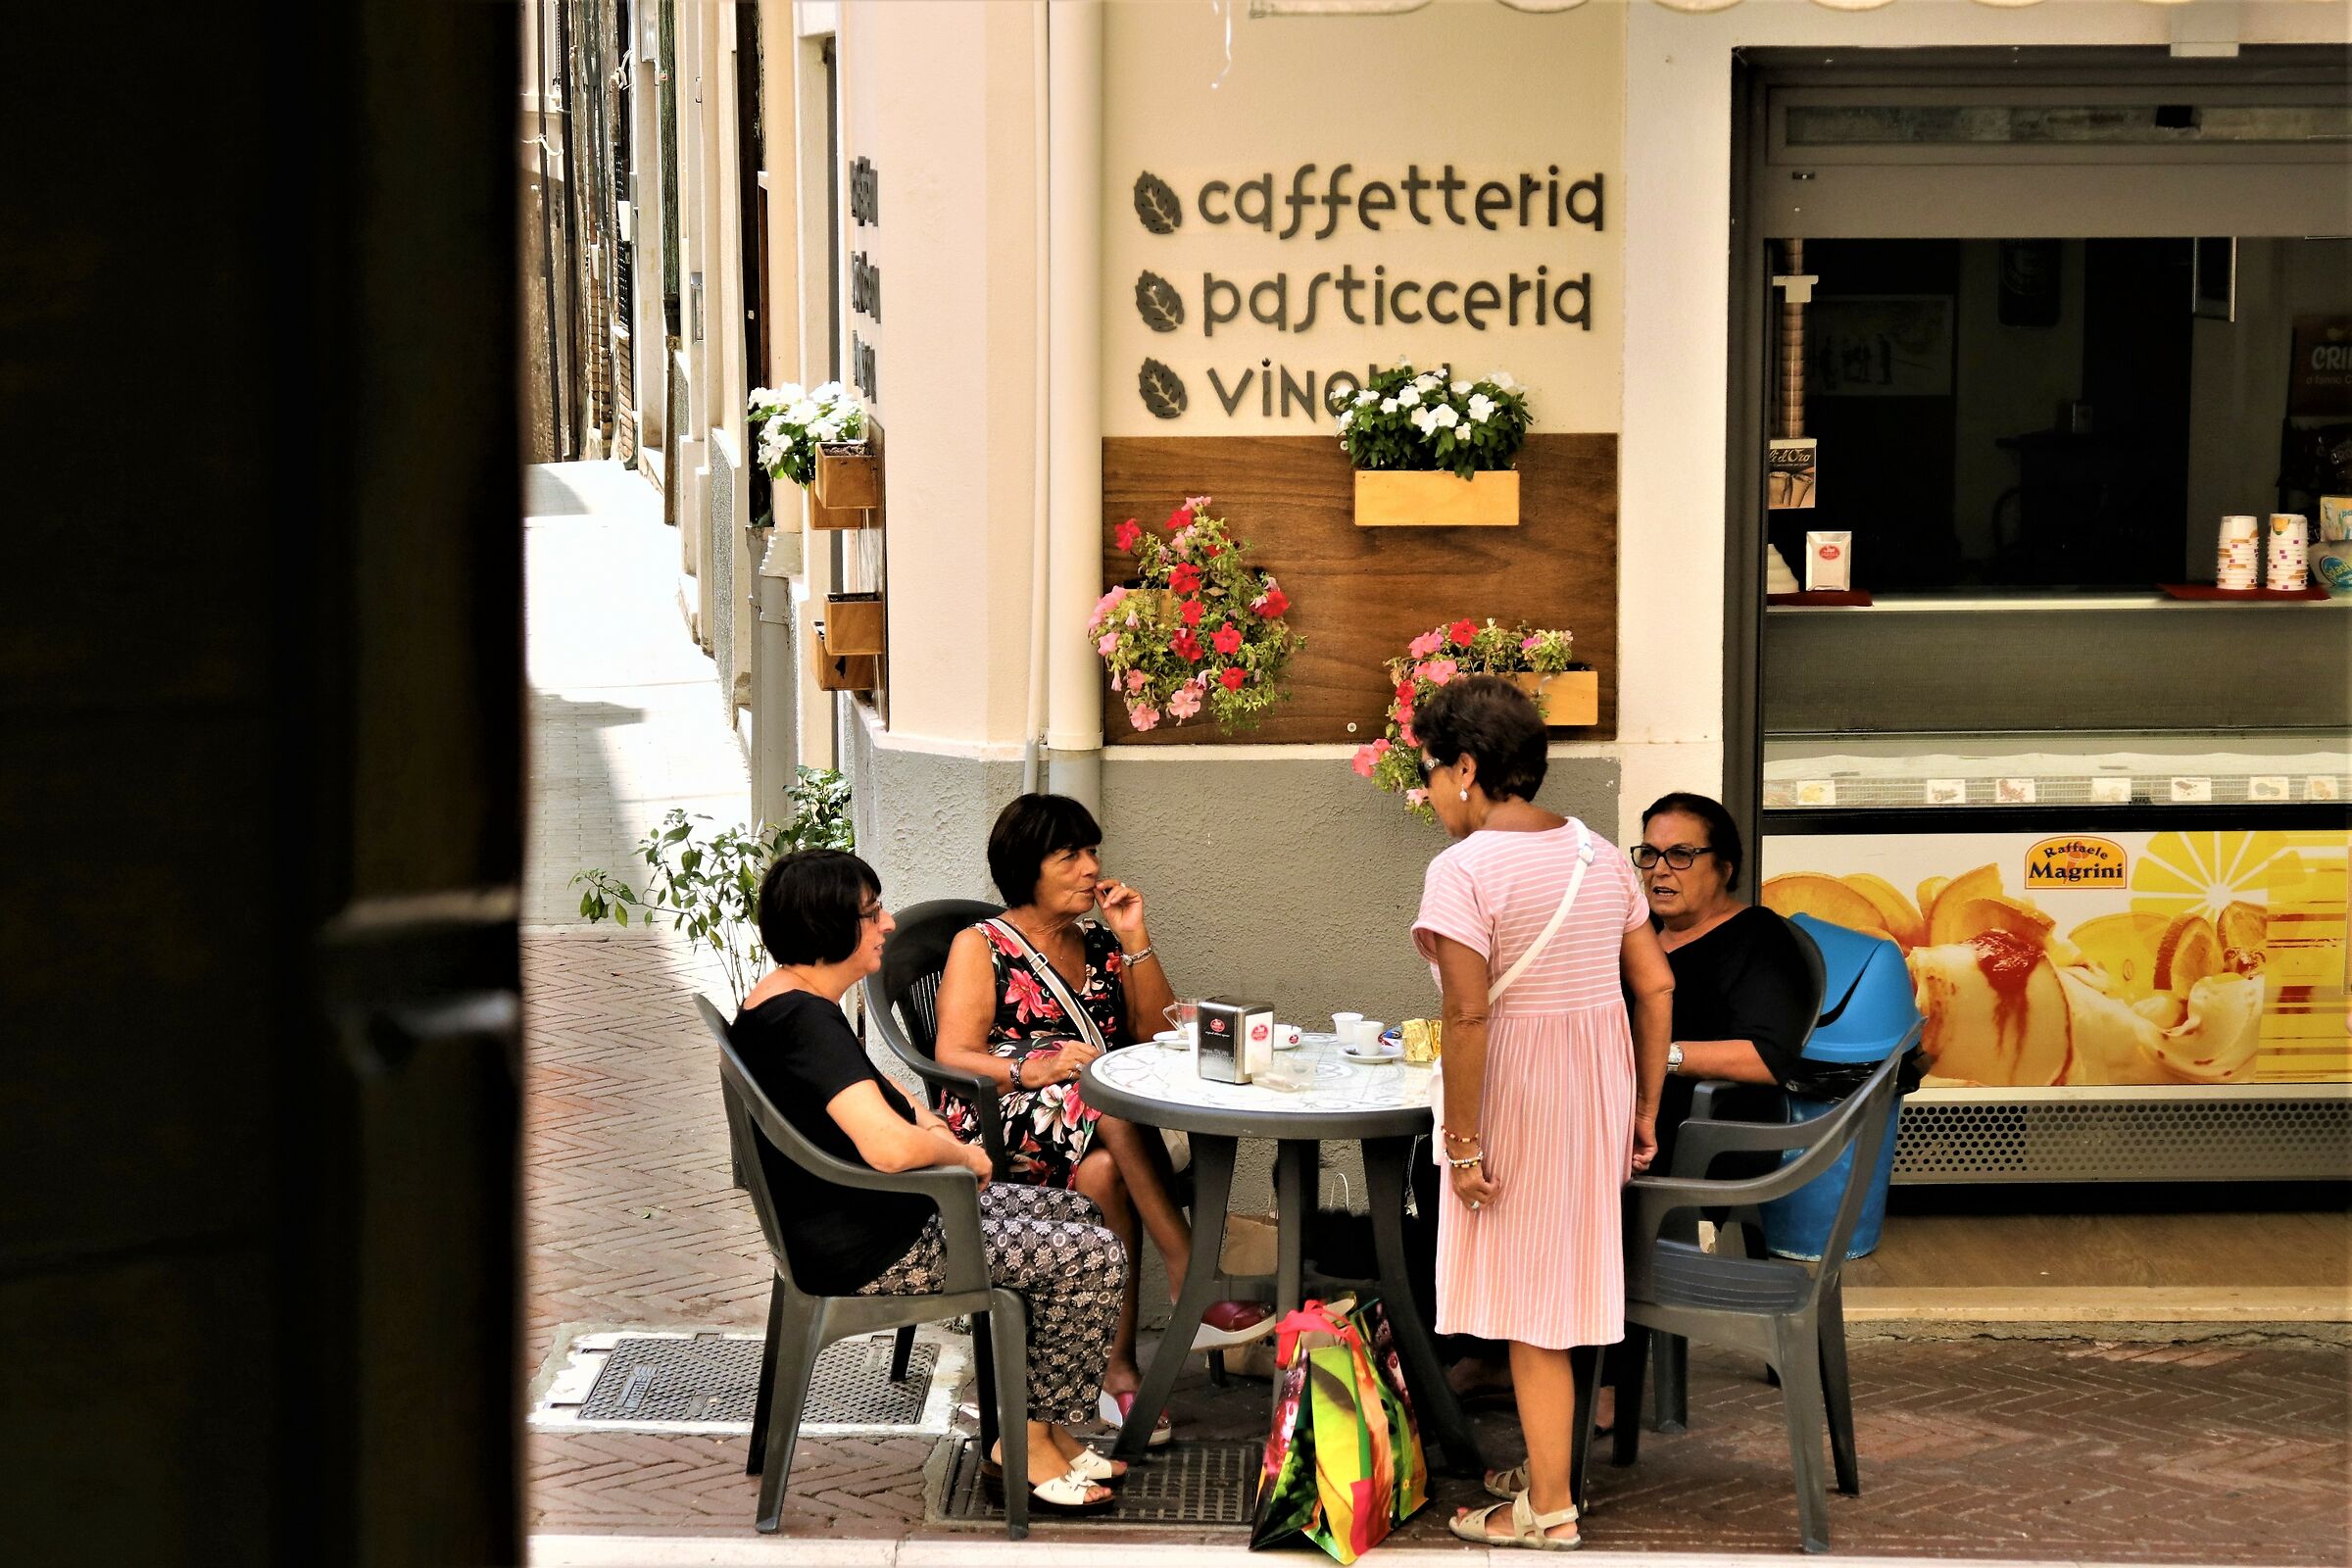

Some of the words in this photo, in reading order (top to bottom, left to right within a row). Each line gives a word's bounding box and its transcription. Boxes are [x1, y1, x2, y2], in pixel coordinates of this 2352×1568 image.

[1198, 163, 1603, 240] caffetteria
[1202, 265, 1592, 337] pasticceria
[2029, 861, 2123, 882] Magrini
[2043, 841, 2108, 860] Raffaele
